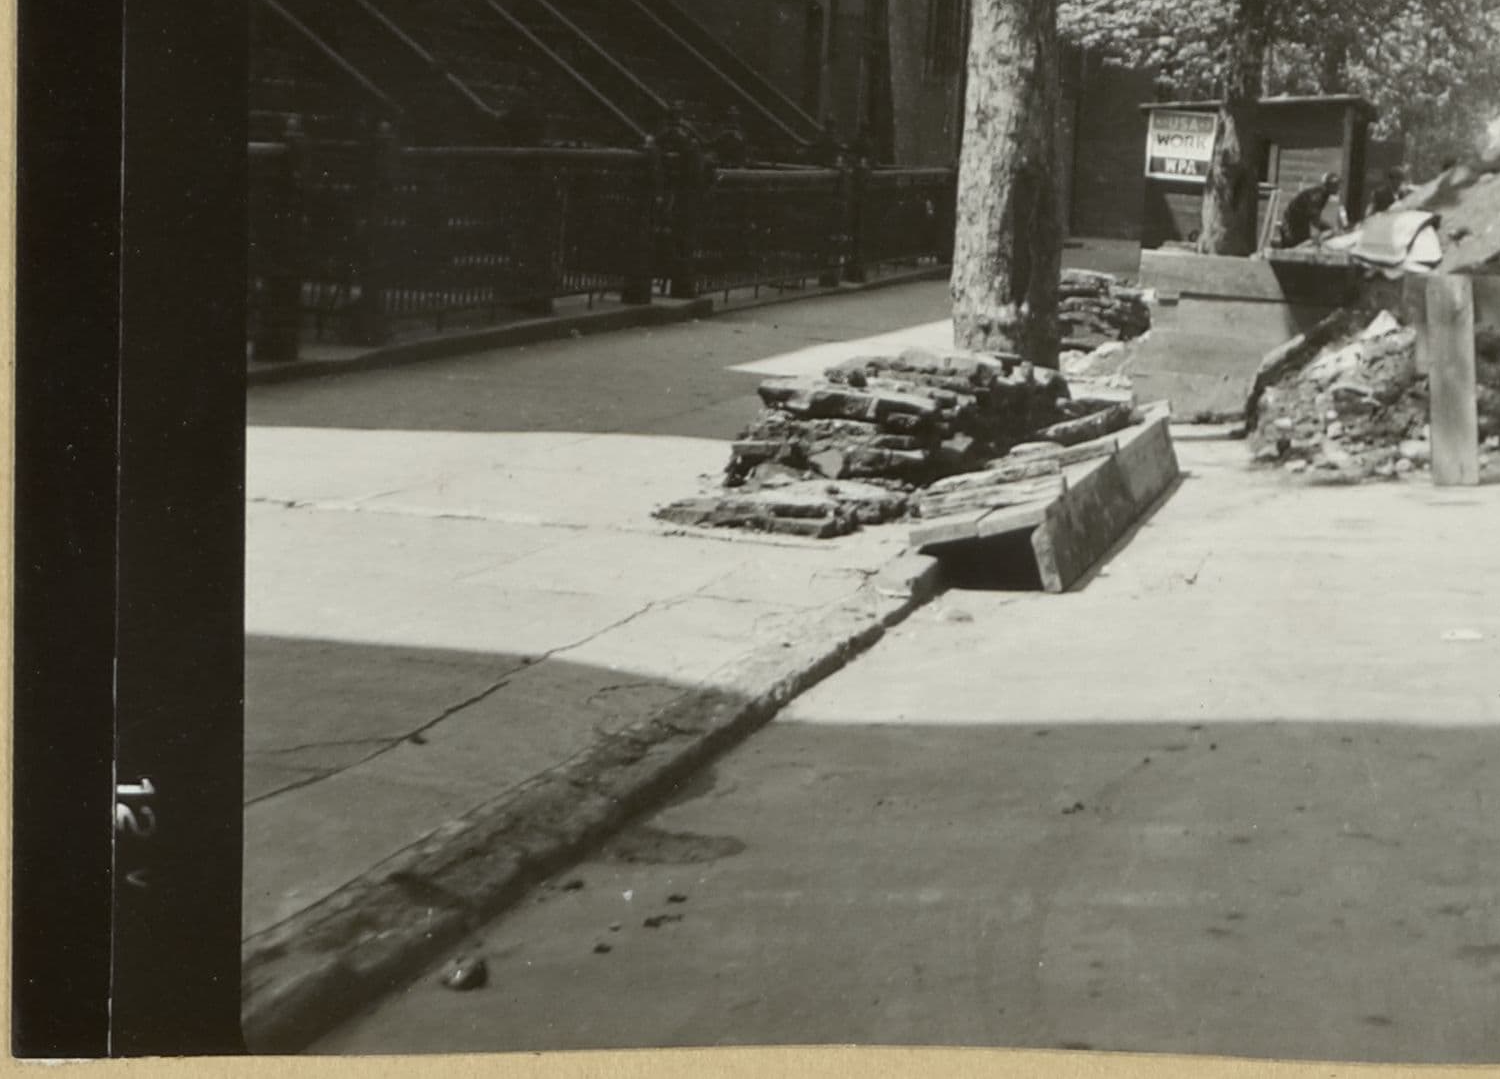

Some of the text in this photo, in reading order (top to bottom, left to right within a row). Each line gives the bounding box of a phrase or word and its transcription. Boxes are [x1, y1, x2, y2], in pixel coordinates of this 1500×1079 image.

[1168, 117, 1198, 133] USA
[1157, 133, 1206, 150] WORK
[1166, 158, 1197, 174] WPA
